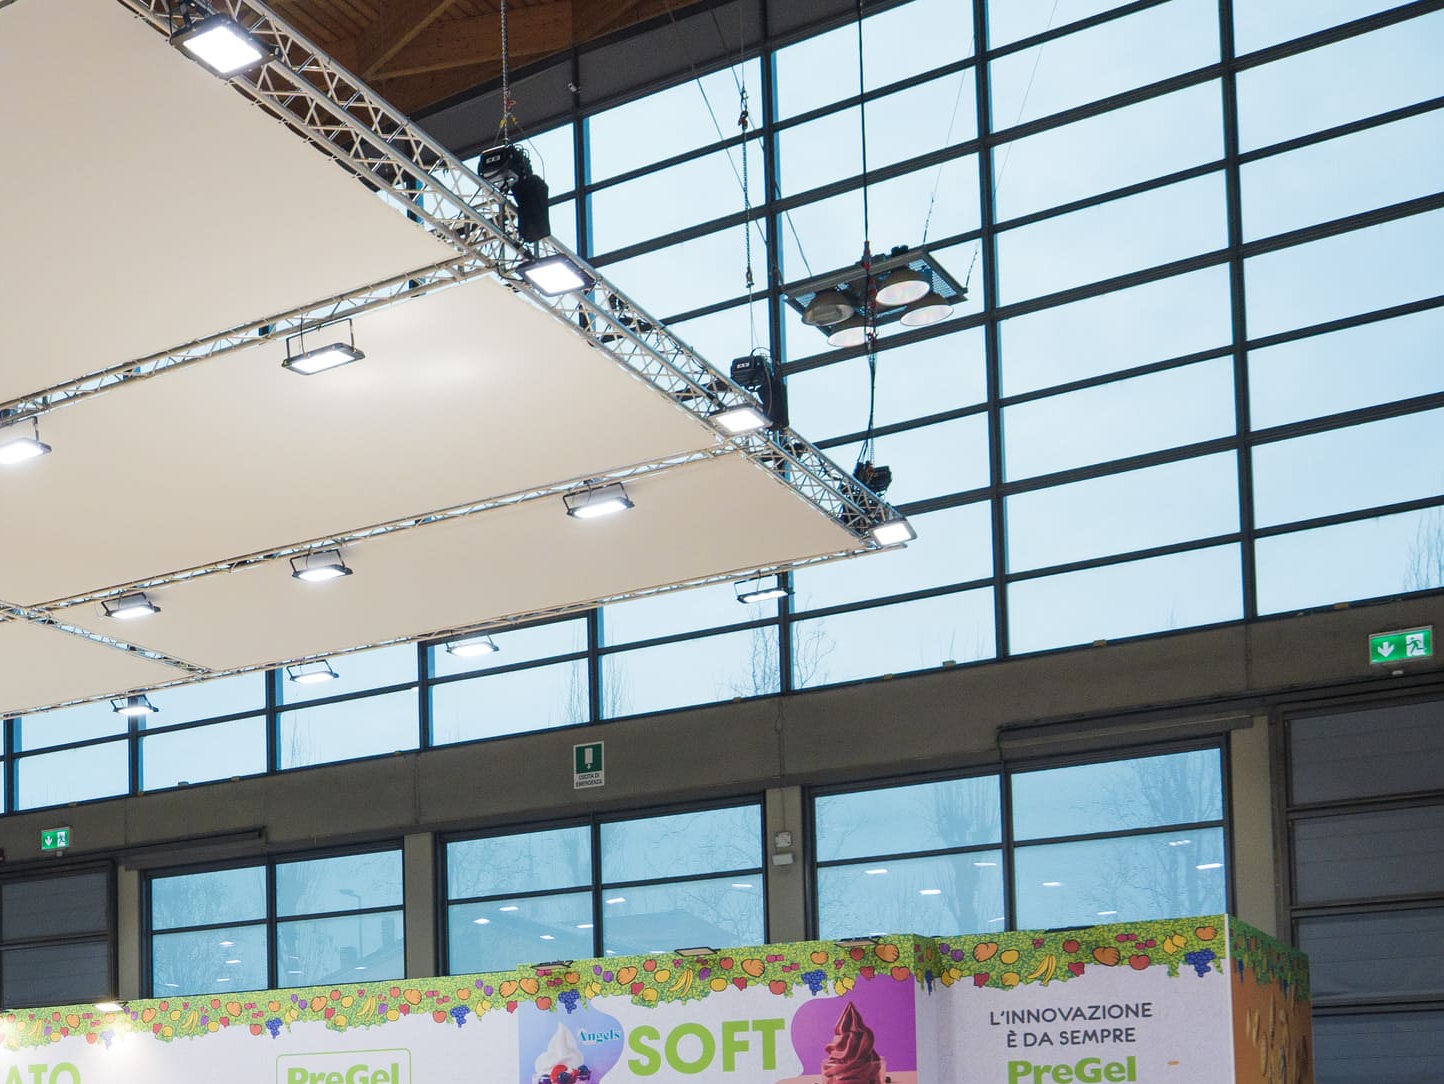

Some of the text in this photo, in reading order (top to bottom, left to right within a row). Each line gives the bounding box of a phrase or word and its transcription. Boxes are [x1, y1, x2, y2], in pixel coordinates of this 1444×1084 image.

[990, 1002, 1153, 1026] L'INNOVAZIONE
[578, 1028, 621, 1043] Angels
[1007, 1027, 1136, 1048] È DA SEMPRE
[627, 1018, 786, 1077] SOFT
